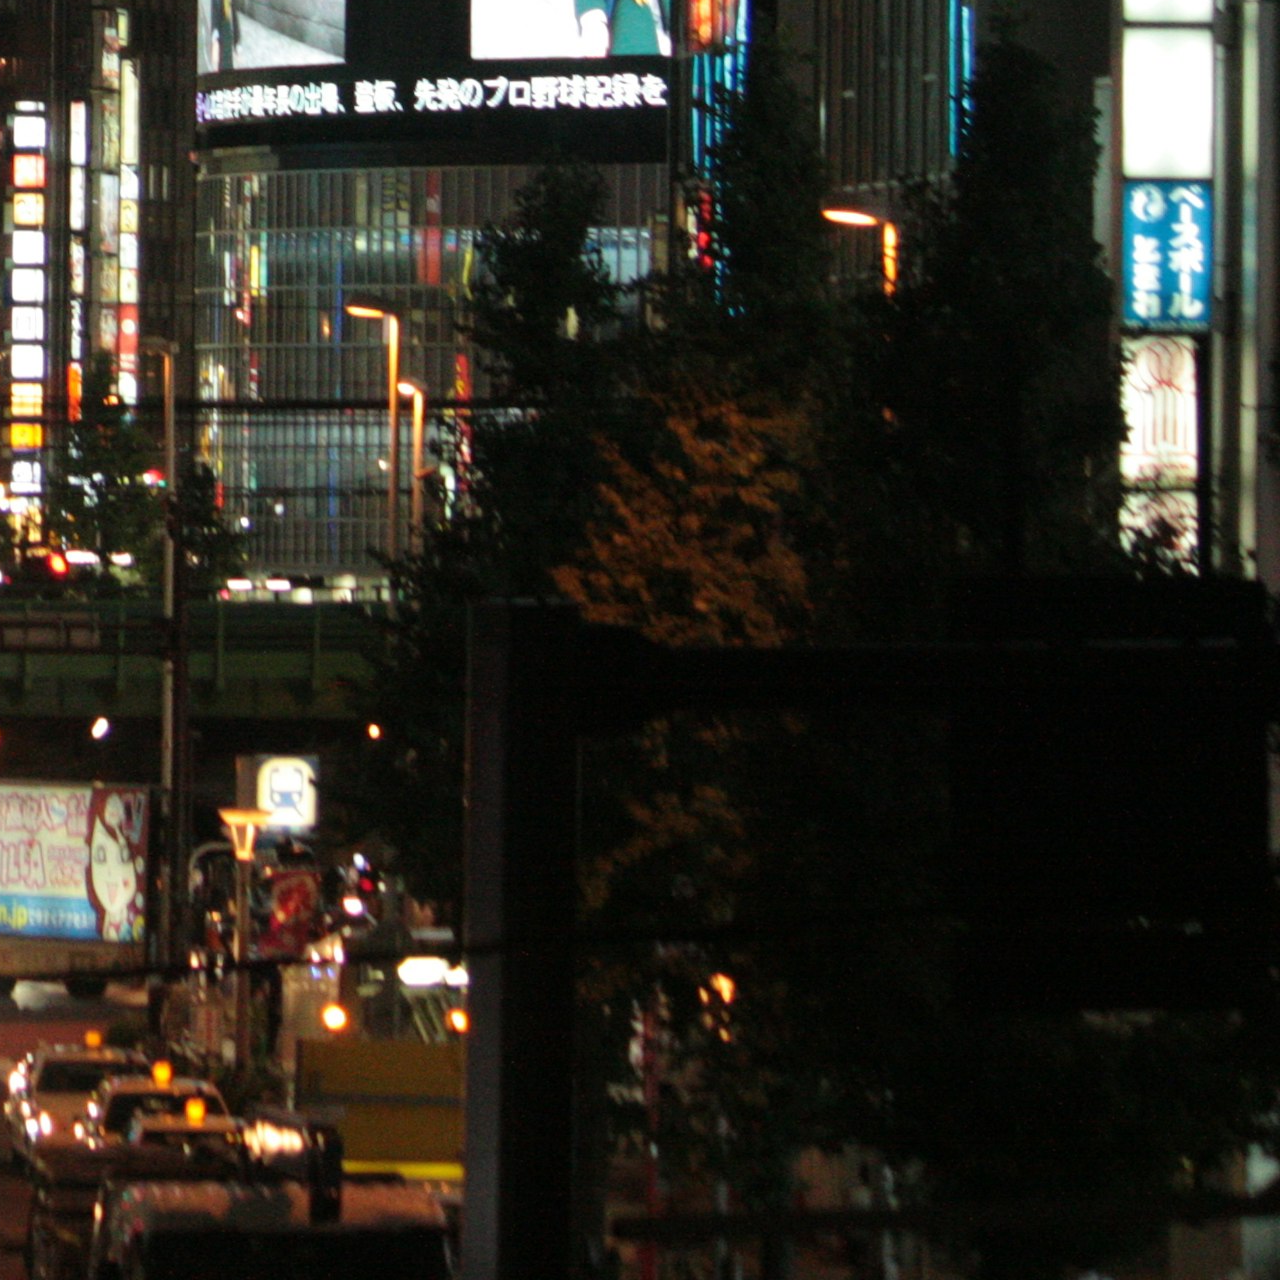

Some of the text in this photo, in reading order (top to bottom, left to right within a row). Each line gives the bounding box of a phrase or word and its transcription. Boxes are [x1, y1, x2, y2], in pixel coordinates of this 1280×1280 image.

[1168, 184, 1205, 319] ベースボール
